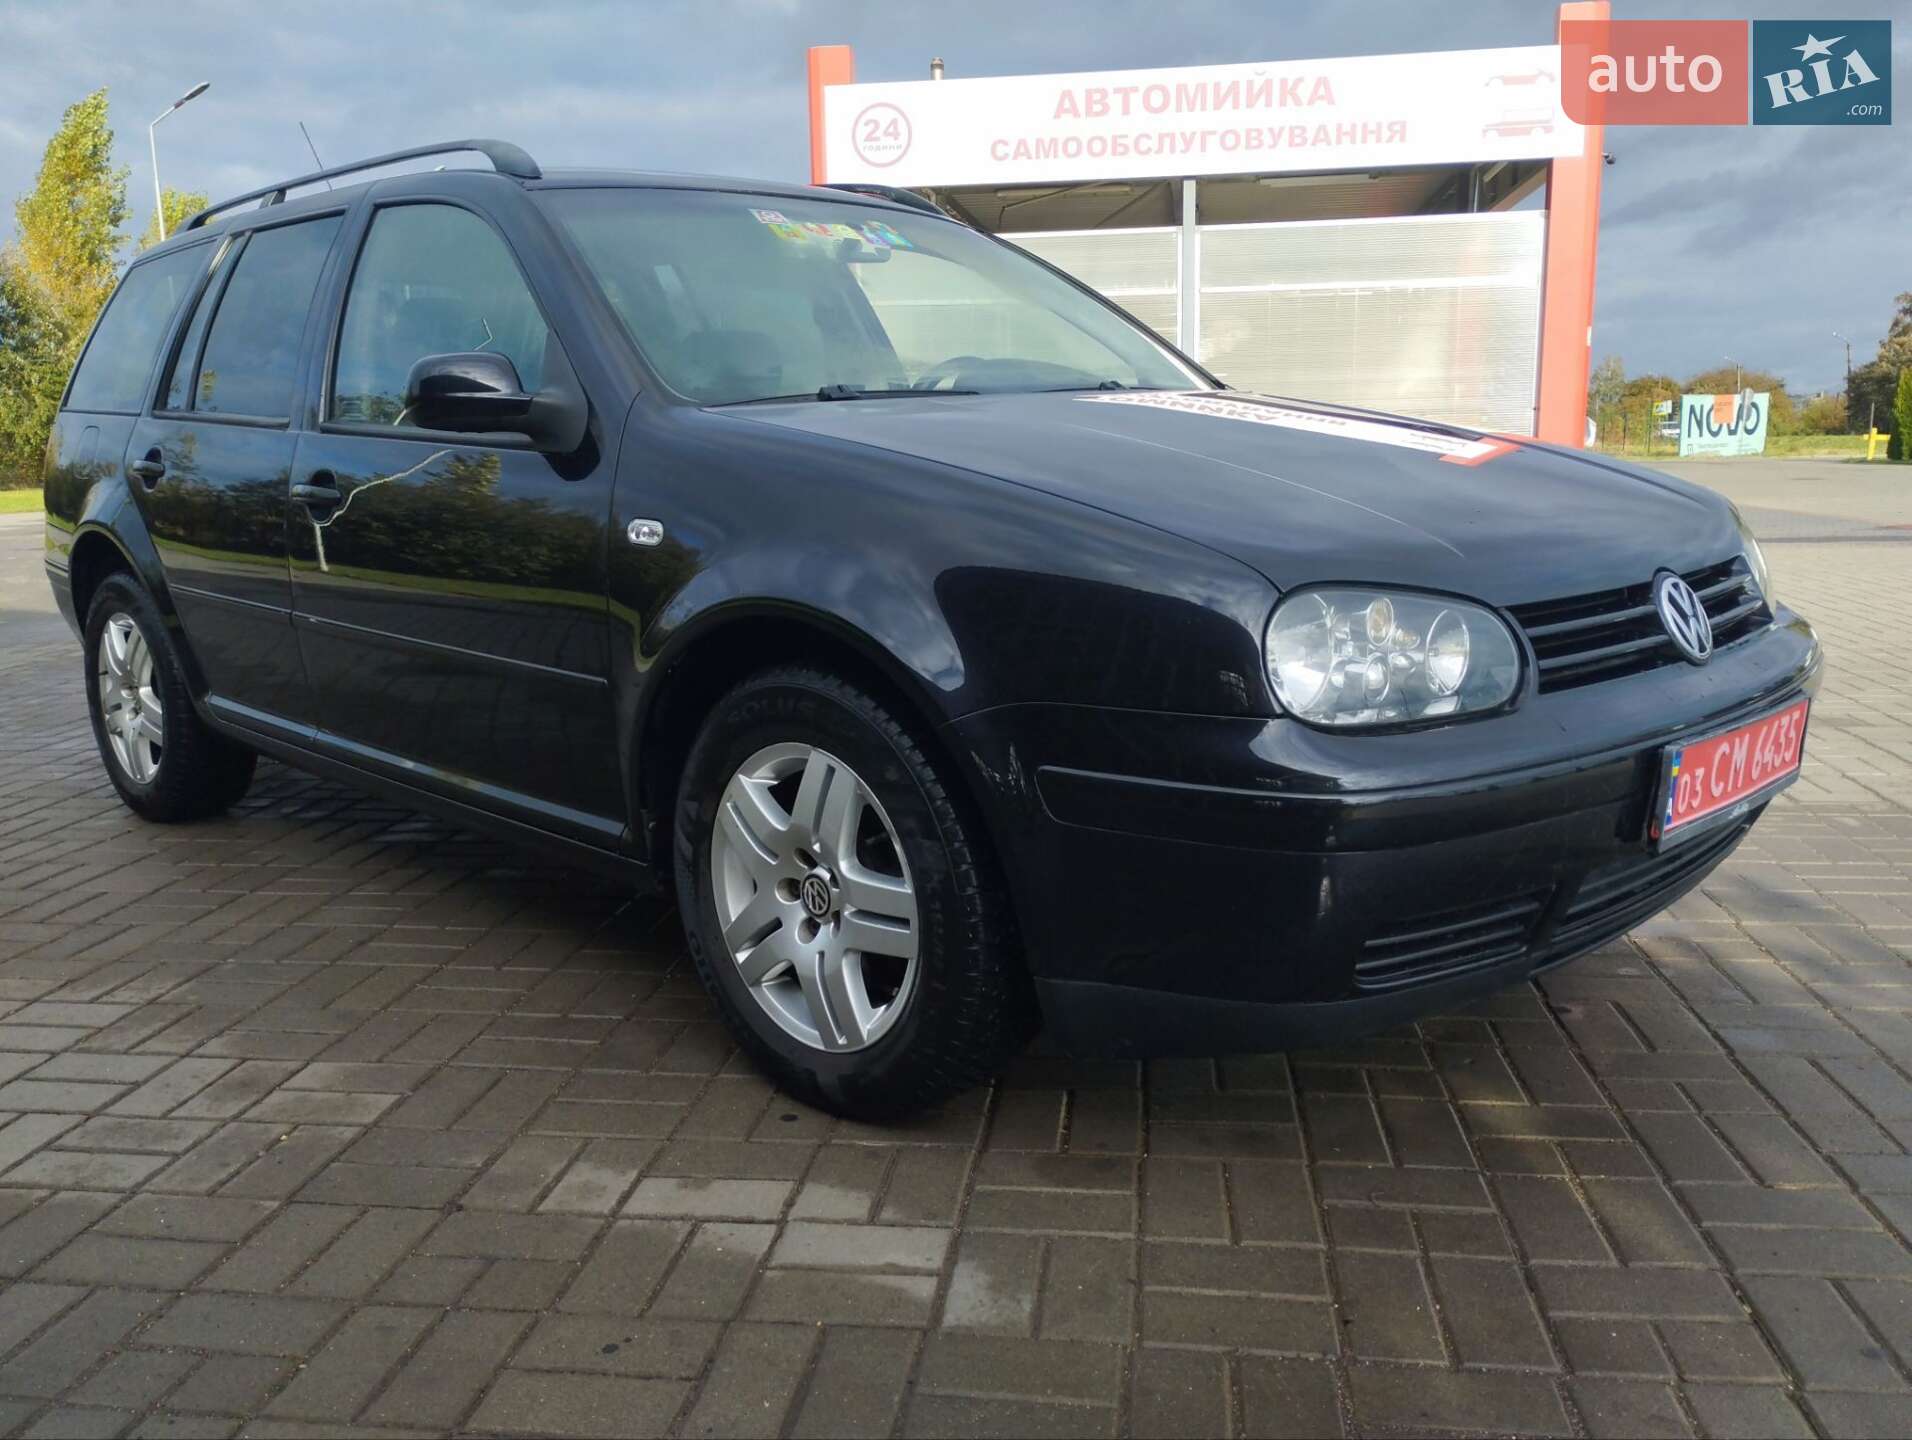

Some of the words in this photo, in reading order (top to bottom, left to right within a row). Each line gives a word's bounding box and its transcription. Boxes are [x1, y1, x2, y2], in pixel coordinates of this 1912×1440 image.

[1053, 71, 1336, 119] АВТОМИЙКА
[863, 118, 901, 142] 24
[990, 121, 1408, 162] САМООБСЛУГОВУВАННЯ
[1677, 767, 1705, 814] 03
[1751, 710, 1801, 781] 6435
